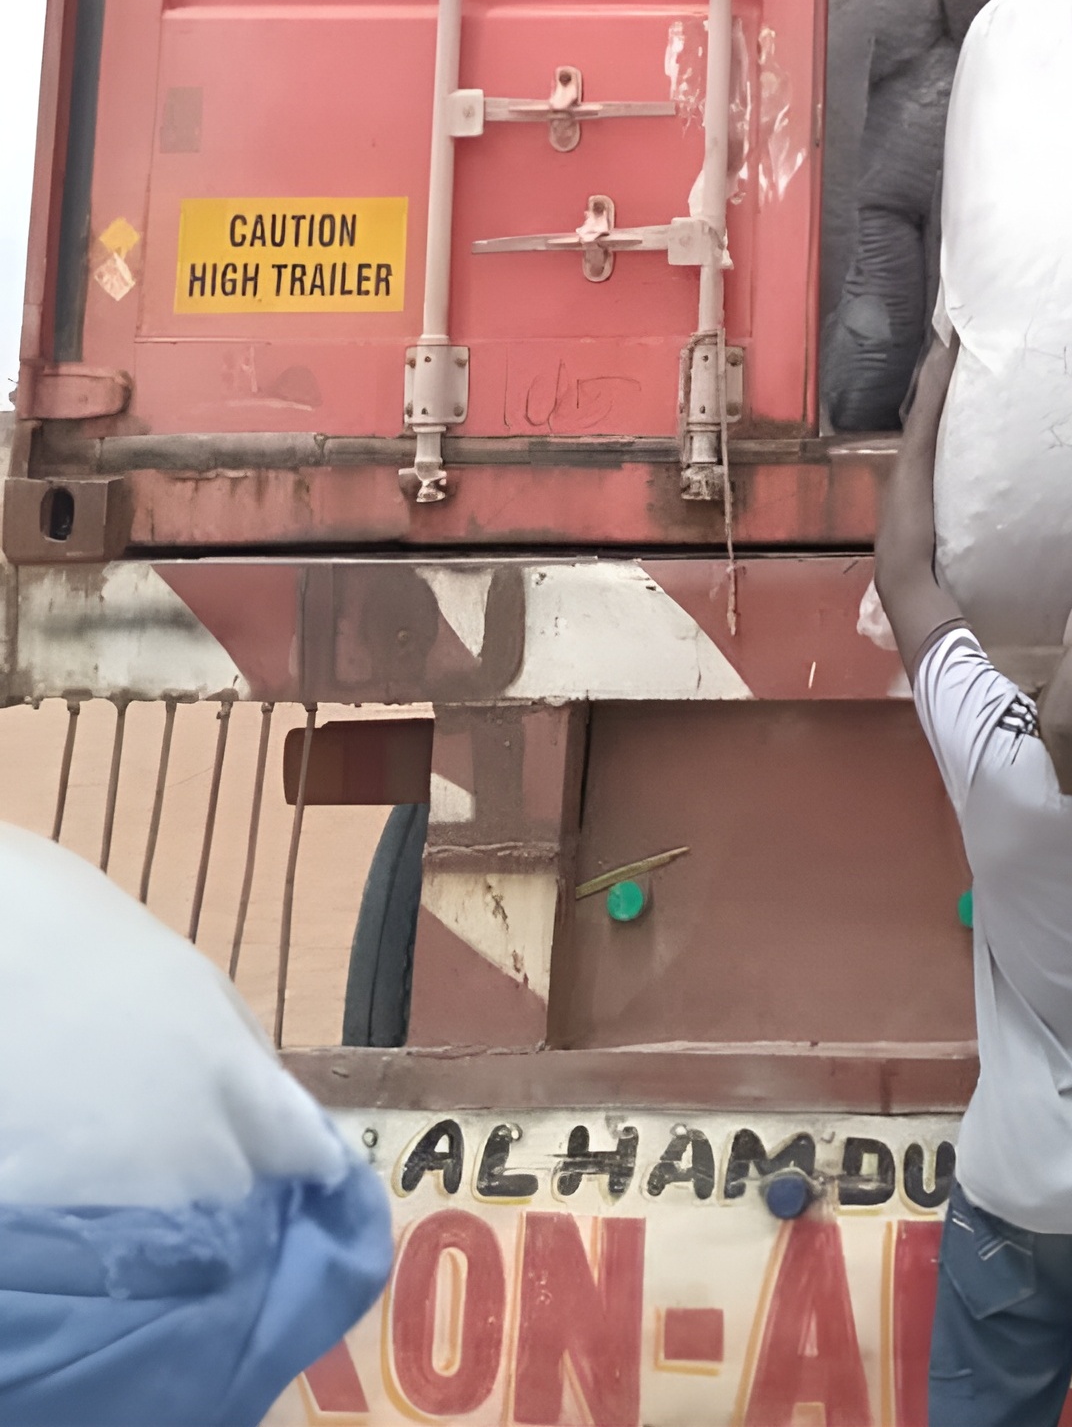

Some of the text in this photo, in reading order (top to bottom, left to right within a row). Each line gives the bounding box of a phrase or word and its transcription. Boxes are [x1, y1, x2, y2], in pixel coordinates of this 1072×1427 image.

[229, 214, 357, 247] CAUTION
[188, 261, 393, 297] HIGH TRAILER
